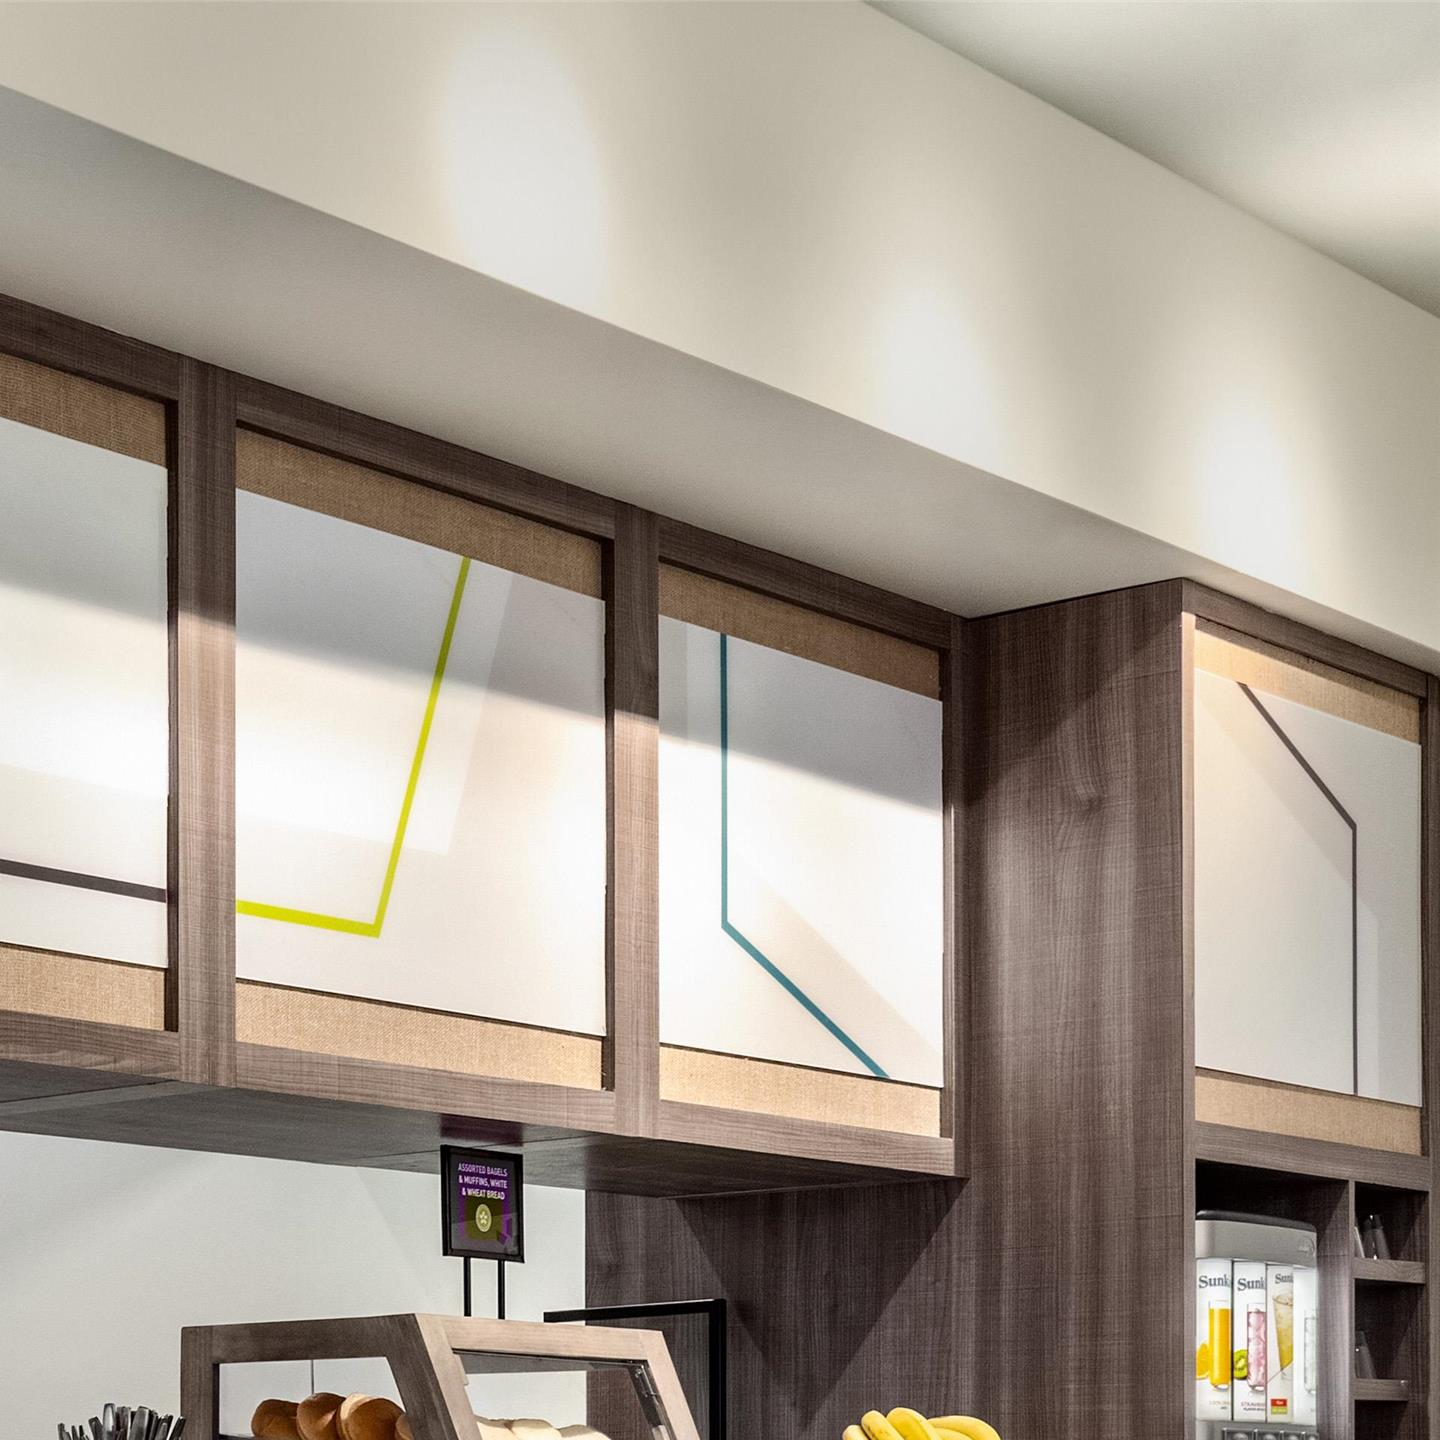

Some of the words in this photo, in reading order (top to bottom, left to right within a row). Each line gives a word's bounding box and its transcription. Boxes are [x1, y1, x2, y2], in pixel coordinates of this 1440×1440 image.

[458, 1163, 486, 1174] ASSORTED
[487, 1166, 508, 1177] BAGELS
[490, 1179, 508, 1189] WHITE
[467, 1188, 486, 1198] WHEAT
[487, 1190, 506, 1200] BREAD
